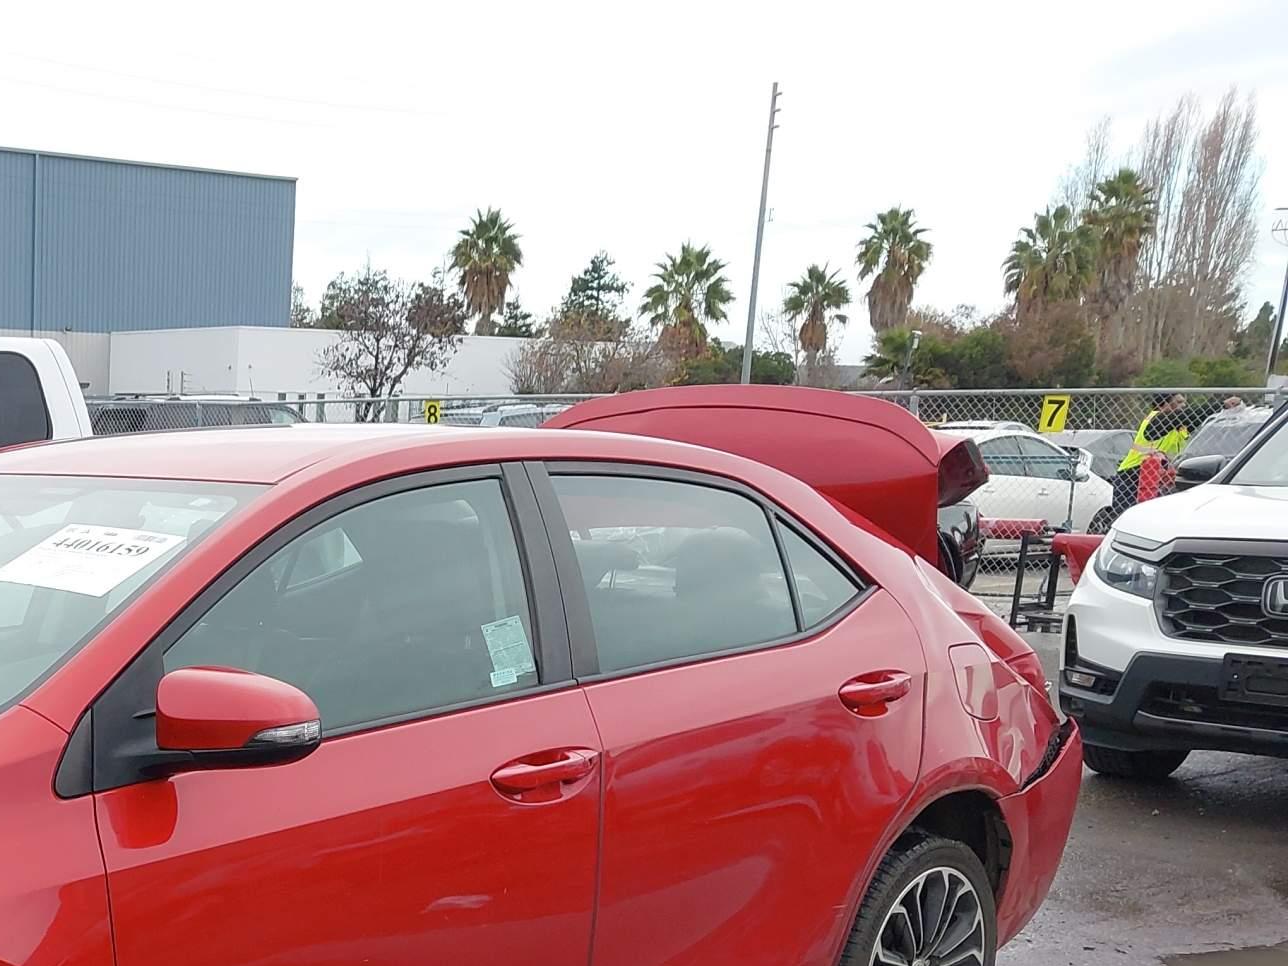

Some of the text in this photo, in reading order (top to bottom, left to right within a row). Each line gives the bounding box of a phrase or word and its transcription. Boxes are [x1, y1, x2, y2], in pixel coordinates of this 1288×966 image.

[427, 404, 438, 424] 8
[1047, 399, 1066, 427] 7
[52, 537, 150, 556] 44016159
